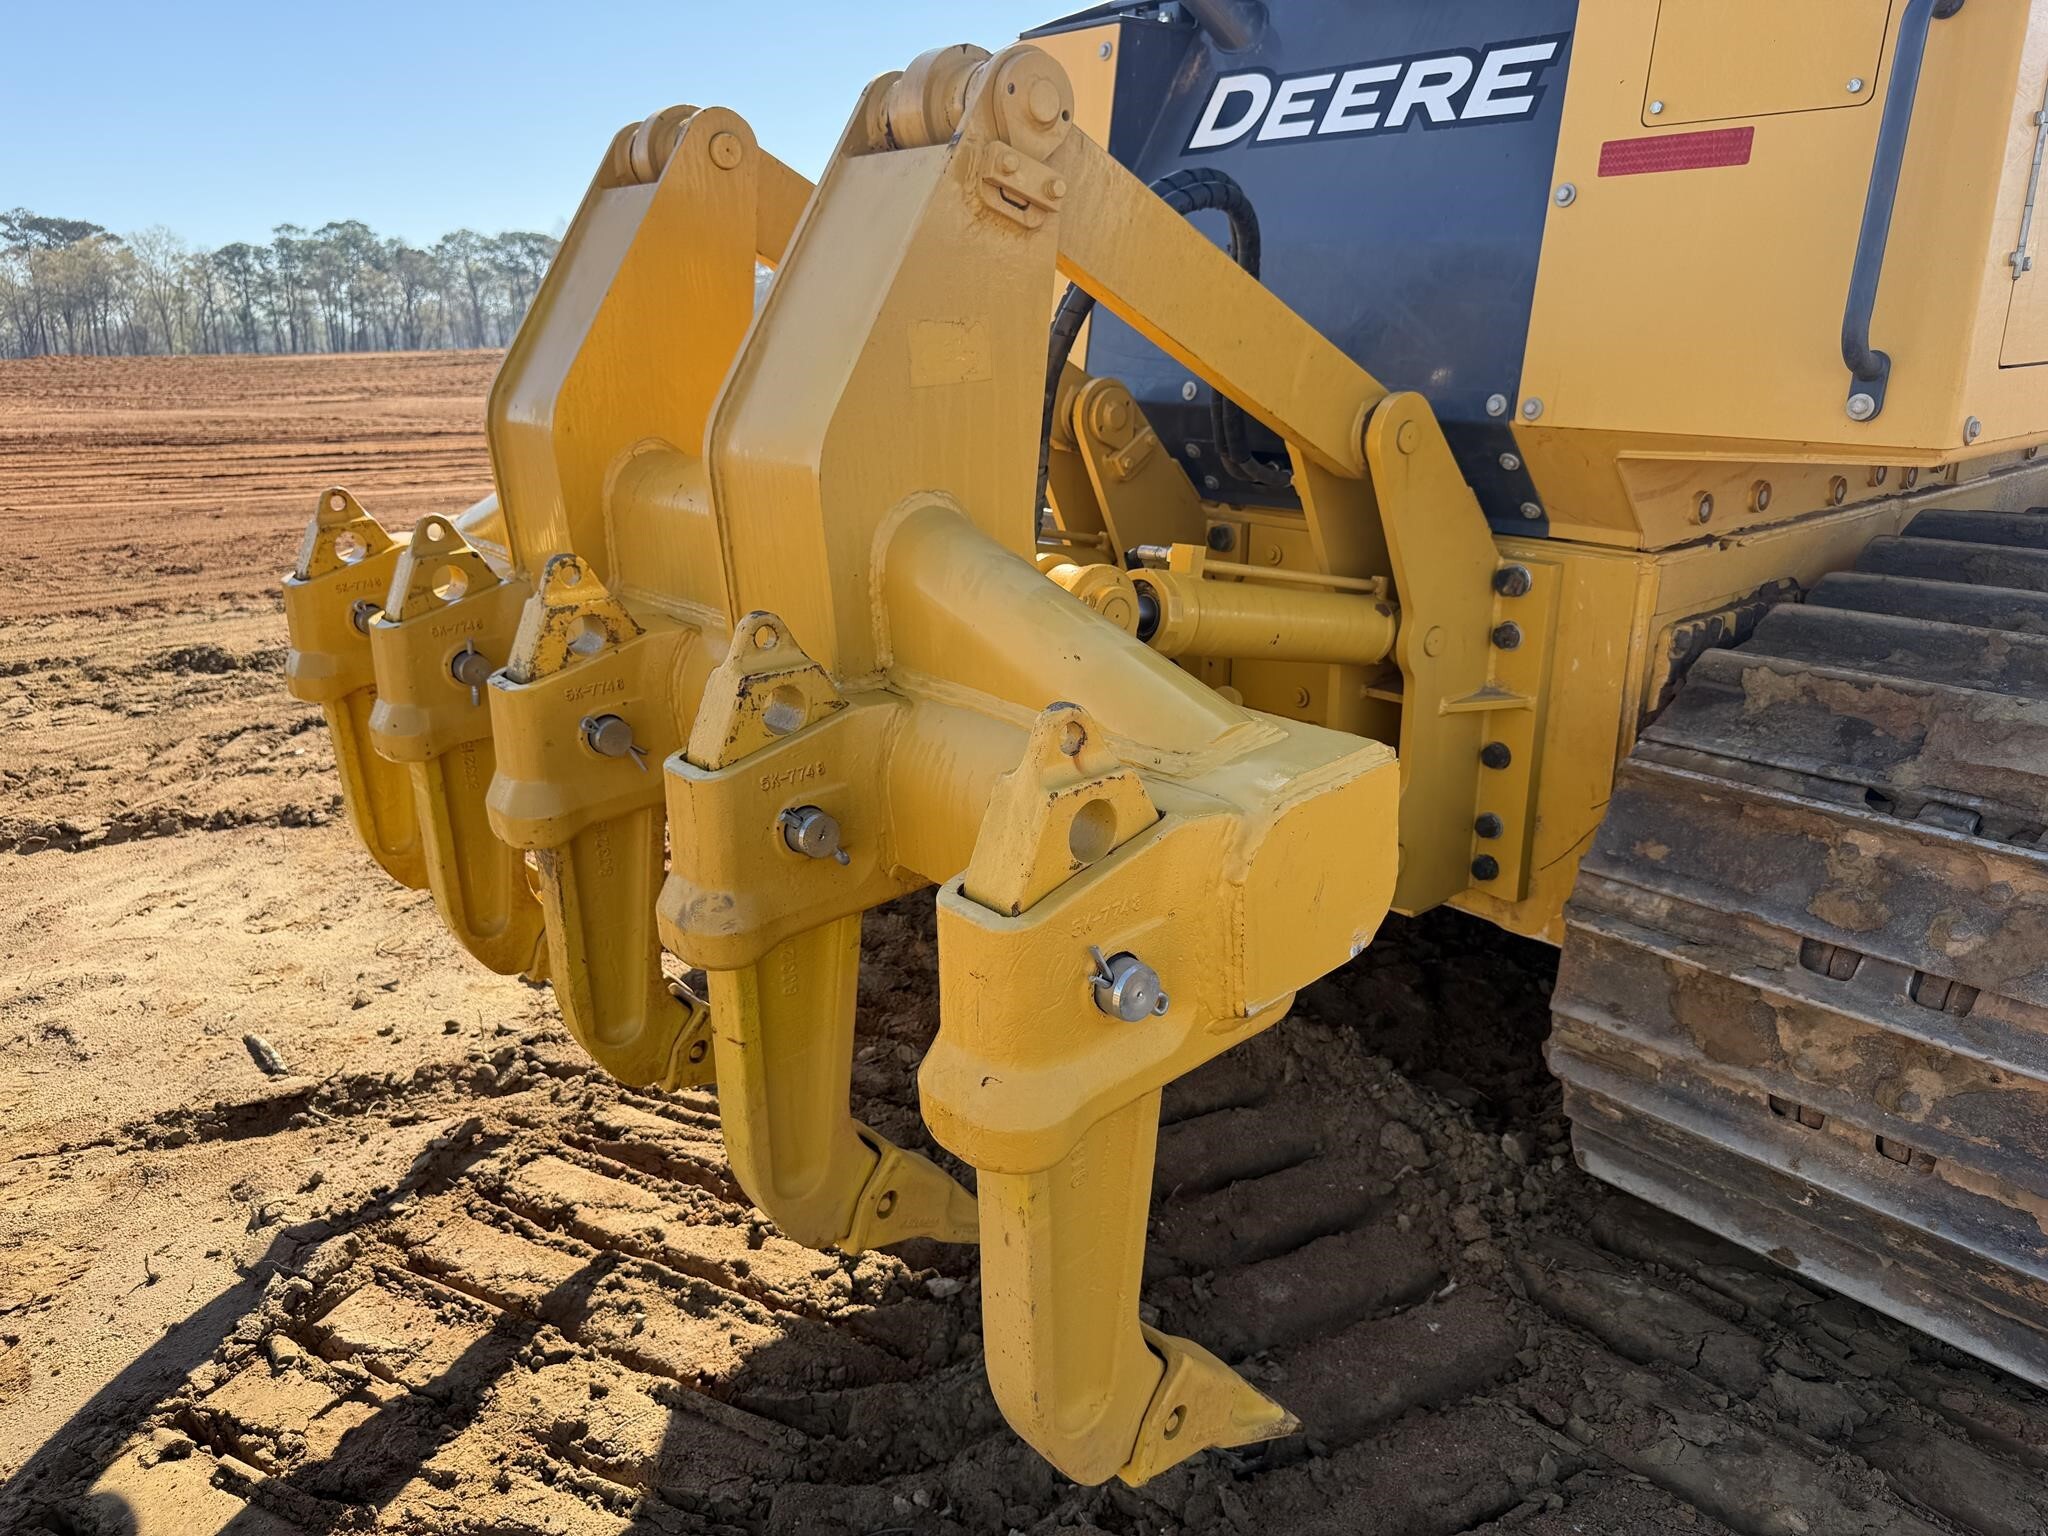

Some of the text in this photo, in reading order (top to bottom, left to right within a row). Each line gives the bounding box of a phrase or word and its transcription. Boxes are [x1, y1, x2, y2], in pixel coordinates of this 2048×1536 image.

[1188, 41, 1558, 149] DEERE
[563, 678, 625, 702] 5K-7748
[760, 760, 826, 792] 5K-7748
[1071, 895, 1143, 938] 5K-7748
